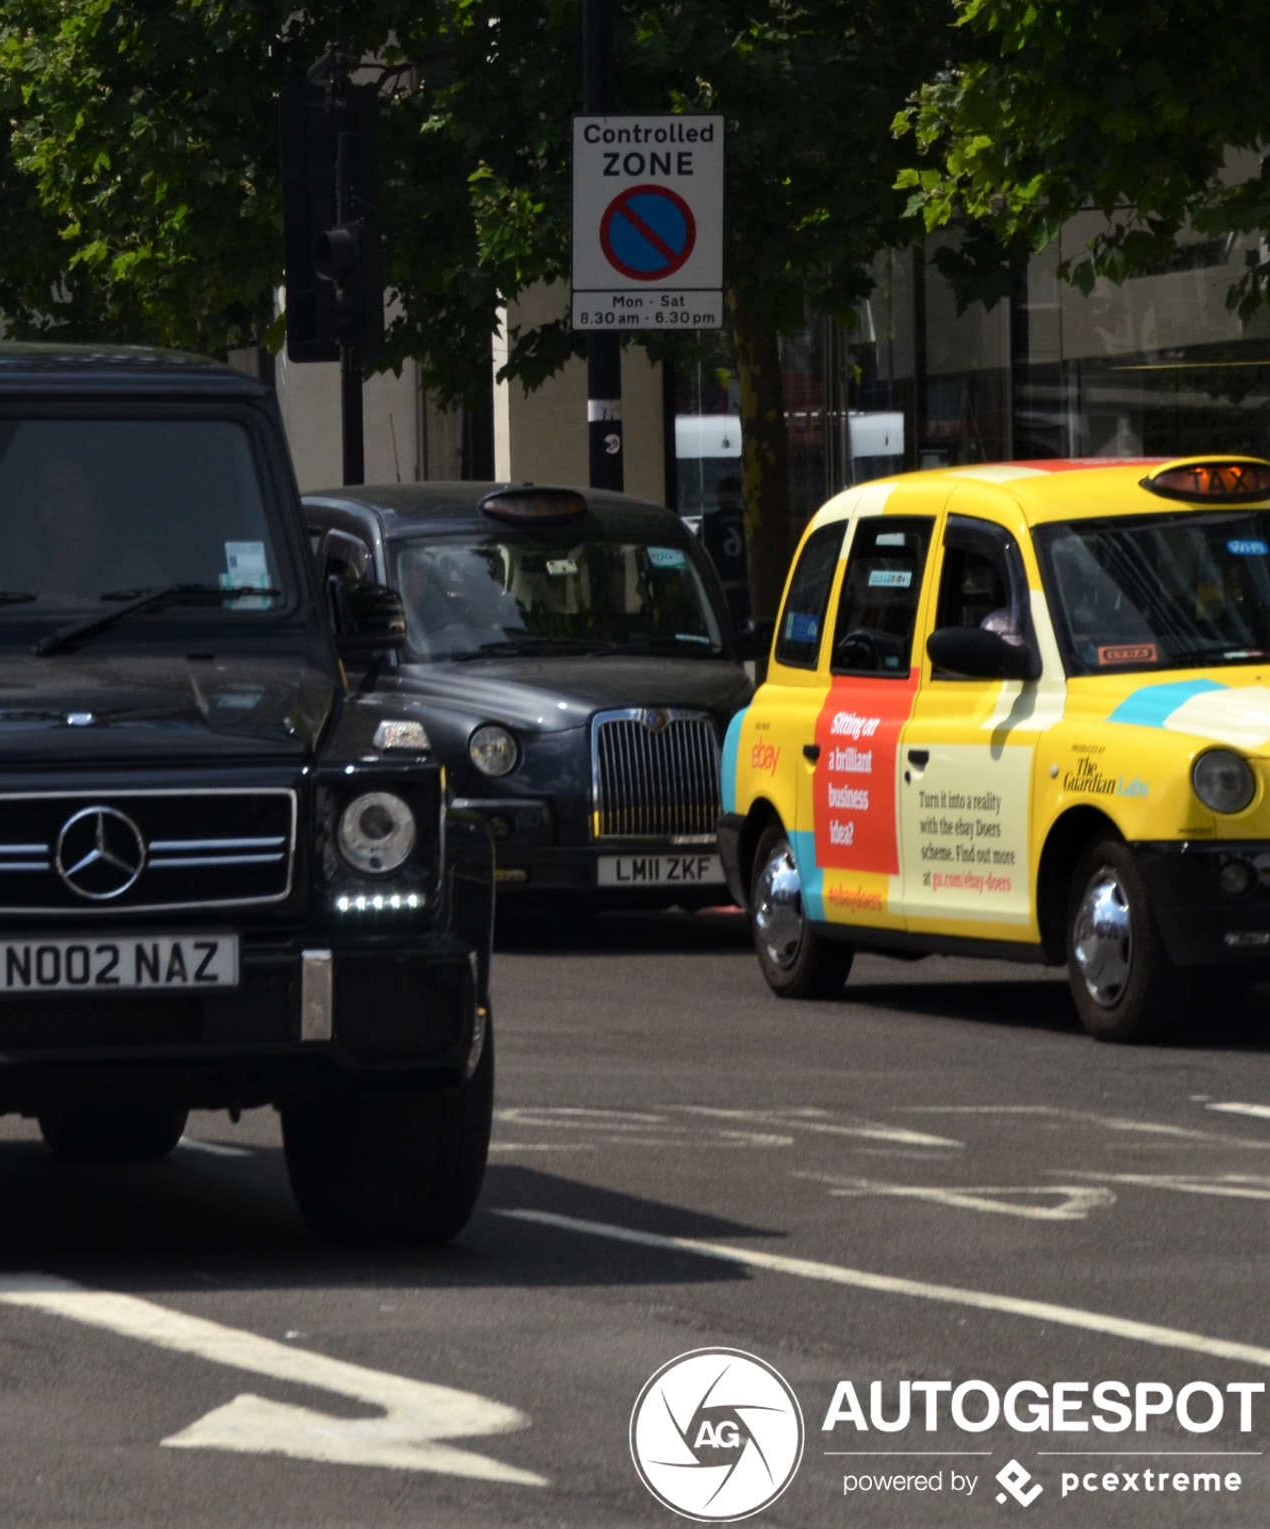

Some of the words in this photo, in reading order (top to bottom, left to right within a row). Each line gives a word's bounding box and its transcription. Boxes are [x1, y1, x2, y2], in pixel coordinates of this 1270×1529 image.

[583, 123, 714, 143] Controlled
[603, 152, 694, 177] ZONE
[612, 296, 643, 308] Mon
[660, 295, 686, 308] Sat
[580, 312, 615, 325] 8.30
[618, 315, 639, 324] am
[655, 312, 690, 324] 6.30
[693, 314, 715, 326] pm
[1187, 469, 1262, 492] TAXI
[830, 711, 865, 740] Sitting
[863, 717, 881, 737] on
[752, 735, 781, 778] ebay
[828, 753, 835, 771] a
[835, 746, 873, 774] brilliant
[1077, 756, 1098, 777] The
[828, 782, 869, 810] business
[1063, 771, 1116, 794] Guardian
[1116, 774, 1149, 798] Labs
[919, 790, 939, 809] Turn
[940, 789, 947, 809] it
[948, 790, 966, 810] into
[967, 795, 972, 810] a
[973, 791, 1002, 816] reality
[829, 819, 855, 846] idea?
[920, 816, 939, 835] with
[939, 816, 954, 836] the
[954, 817, 975, 841] ebay
[975, 818, 1001, 838] Doers
[921, 841, 955, 861] scheme.
[955, 844, 975, 863] Find
[976, 847, 991, 864] out
[992, 849, 1016, 866] more
[666, 857, 711, 881] ZKF
[923, 870, 931, 887] at
[5, 943, 121, 987] NO02
[134, 941, 220, 984] NAZ
